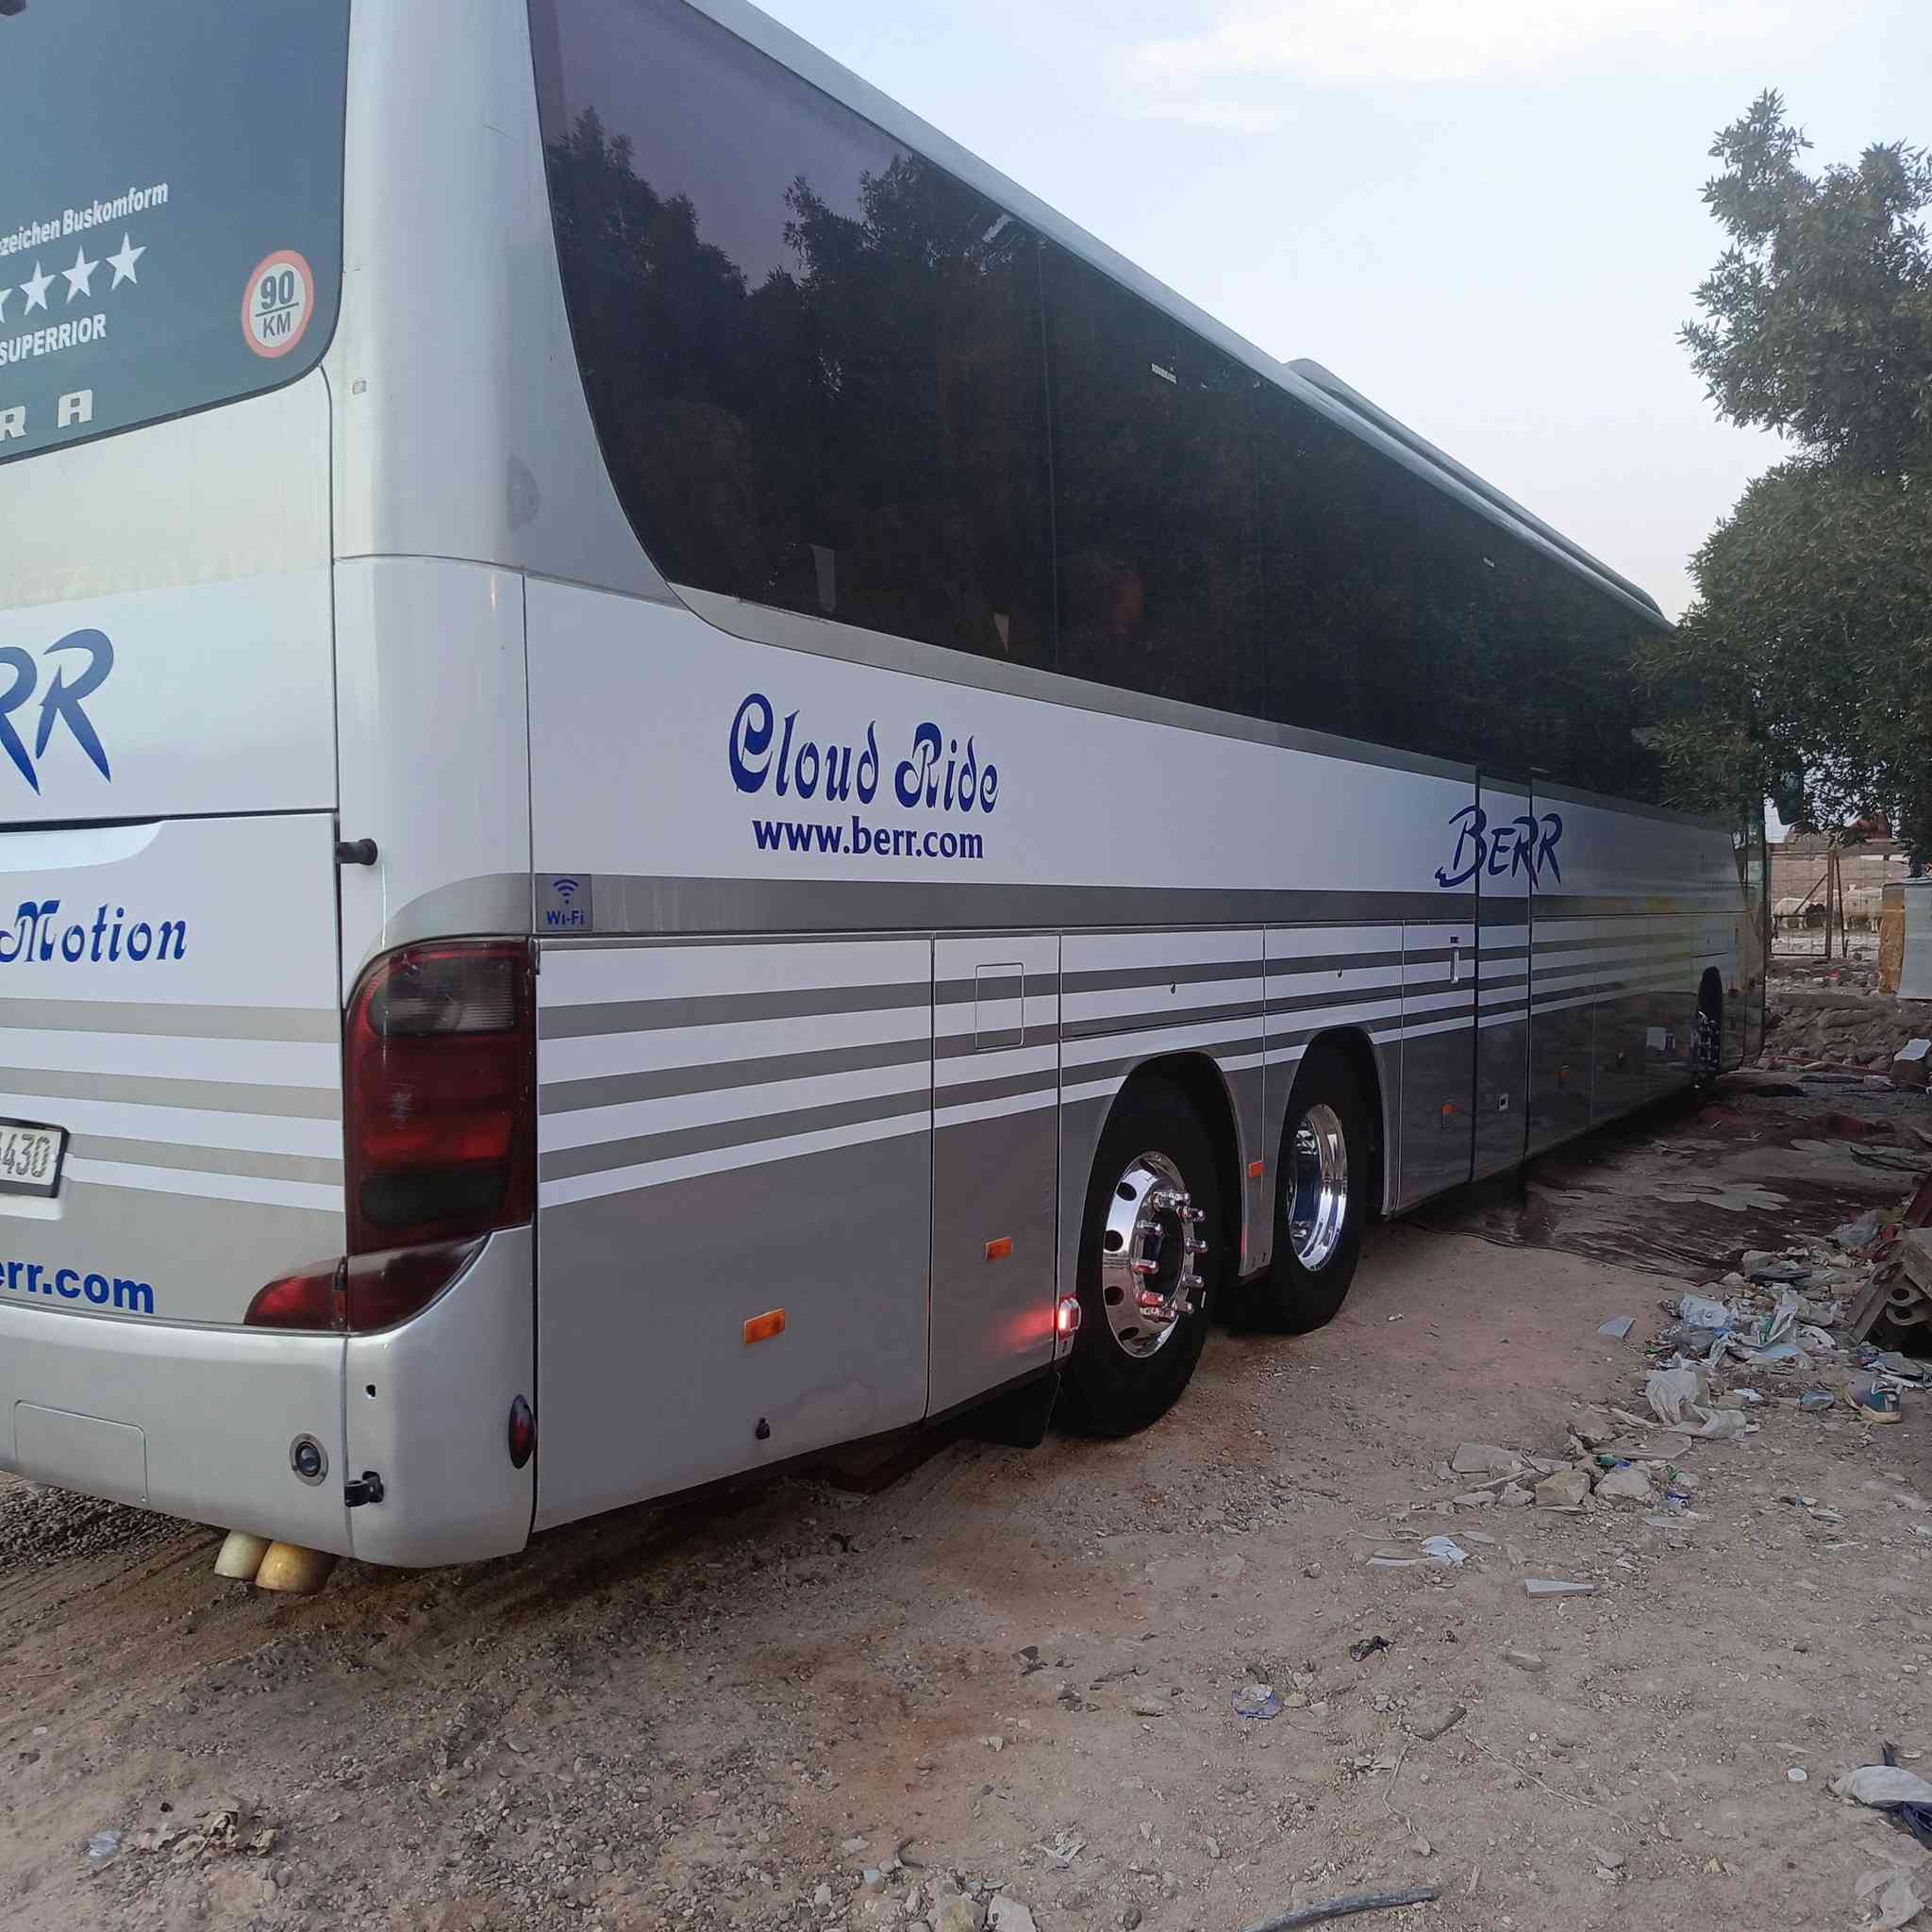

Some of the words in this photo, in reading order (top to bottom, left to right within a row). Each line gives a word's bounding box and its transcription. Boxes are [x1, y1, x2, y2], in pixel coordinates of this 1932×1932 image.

[61, 182, 169, 236] Buskomform
[260, 270, 294, 309] 90
[0, 313, 107, 367] SUPERRIOR
[263, 310, 291, 339] KM
[728, 692, 879, 805] Cloud
[894, 722, 999, 814] Ride
[751, 815, 984, 859] www.berr.com
[1434, 805, 1563, 890] BERR
[0, 899, 188, 963] Motion
[546, 910, 584, 925] Wi-Fi
[0, 1132, 51, 1178] 430
[0, 1260, 155, 1314] rr.com
